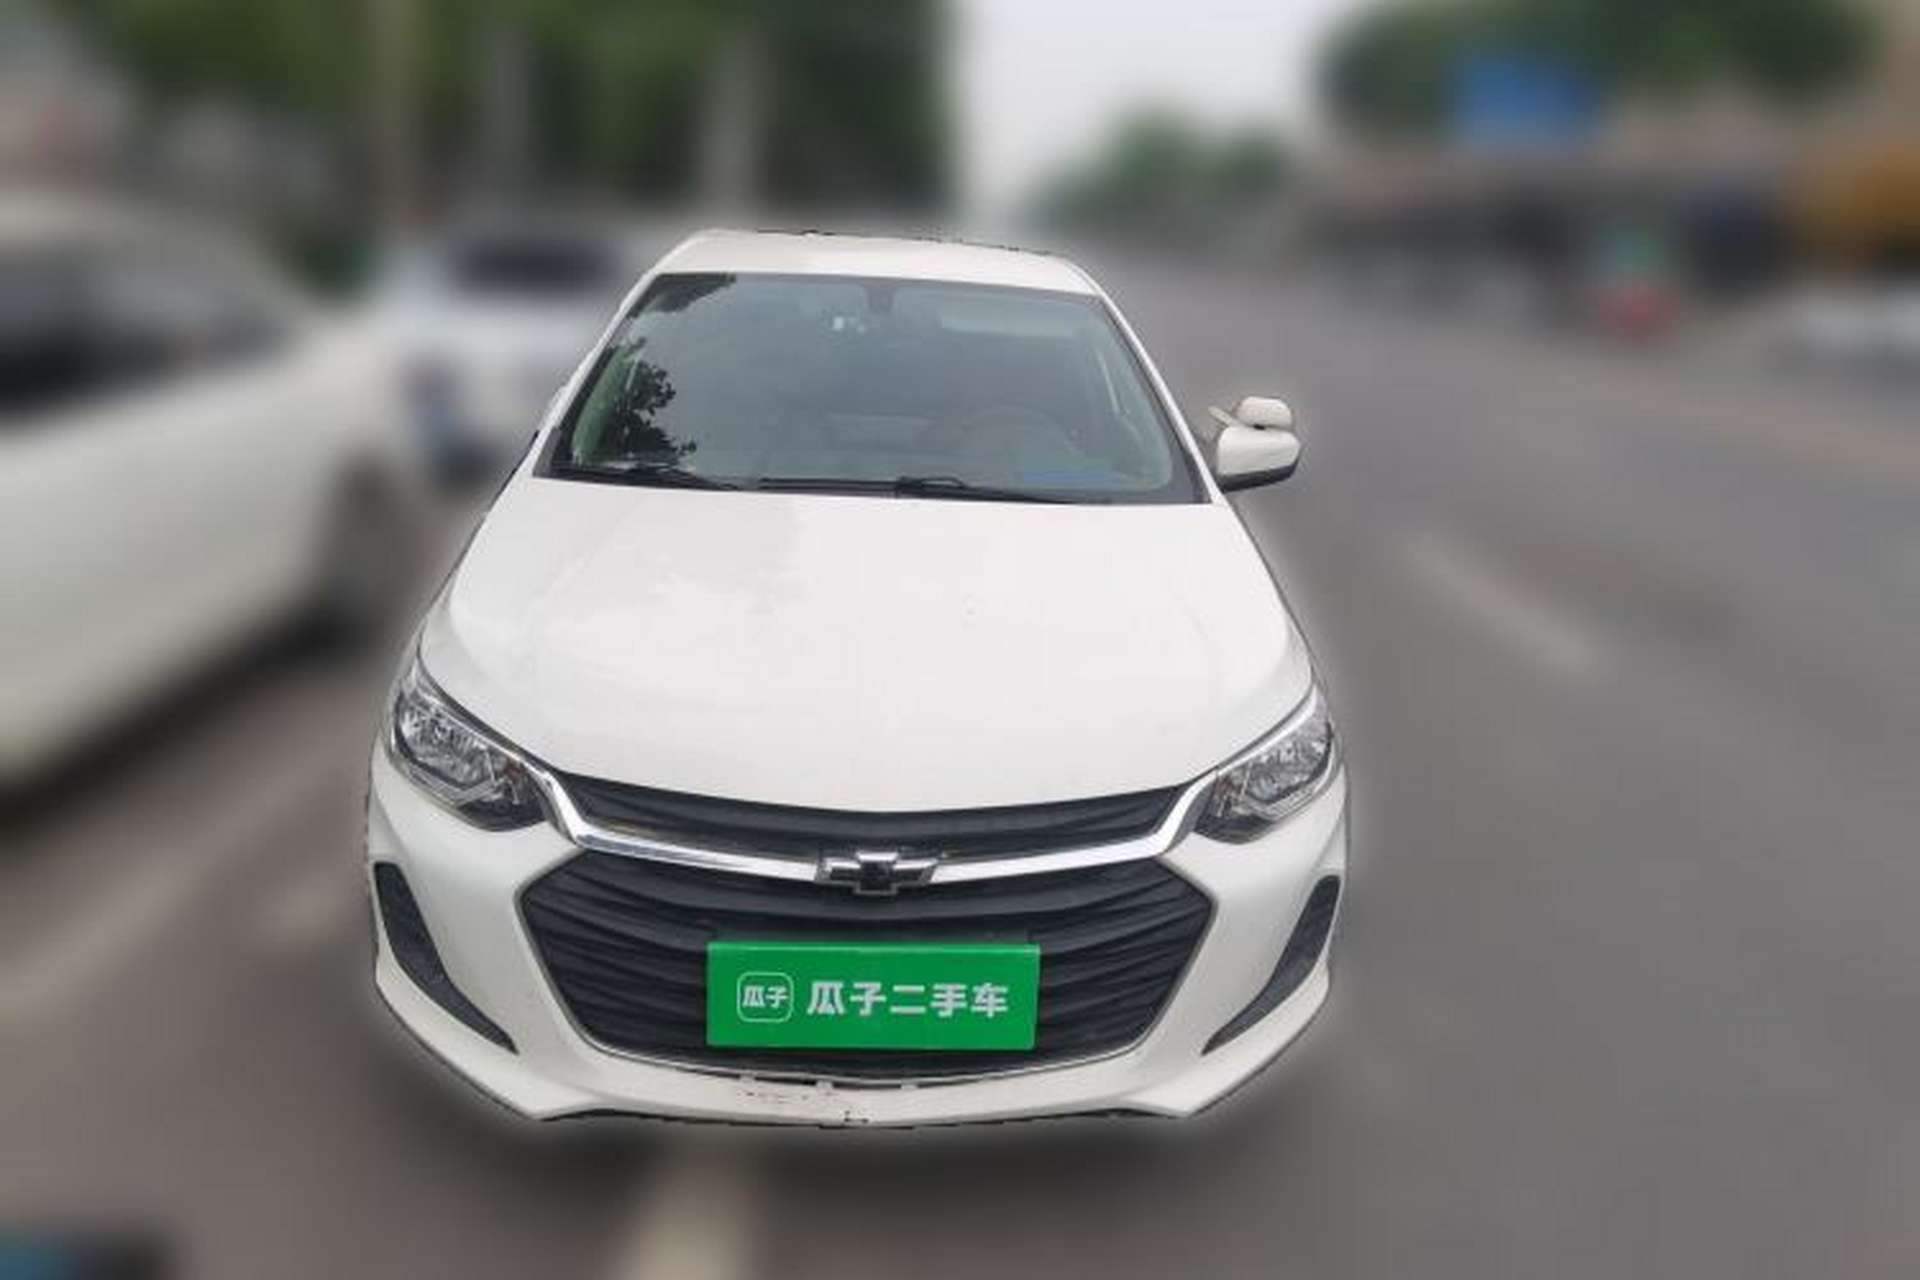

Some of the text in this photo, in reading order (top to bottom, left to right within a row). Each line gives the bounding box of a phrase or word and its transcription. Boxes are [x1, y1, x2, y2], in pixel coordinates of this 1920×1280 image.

[742, 985, 789, 1009] 瓜子
[806, 981, 1008, 1018] 瓜子二手车
